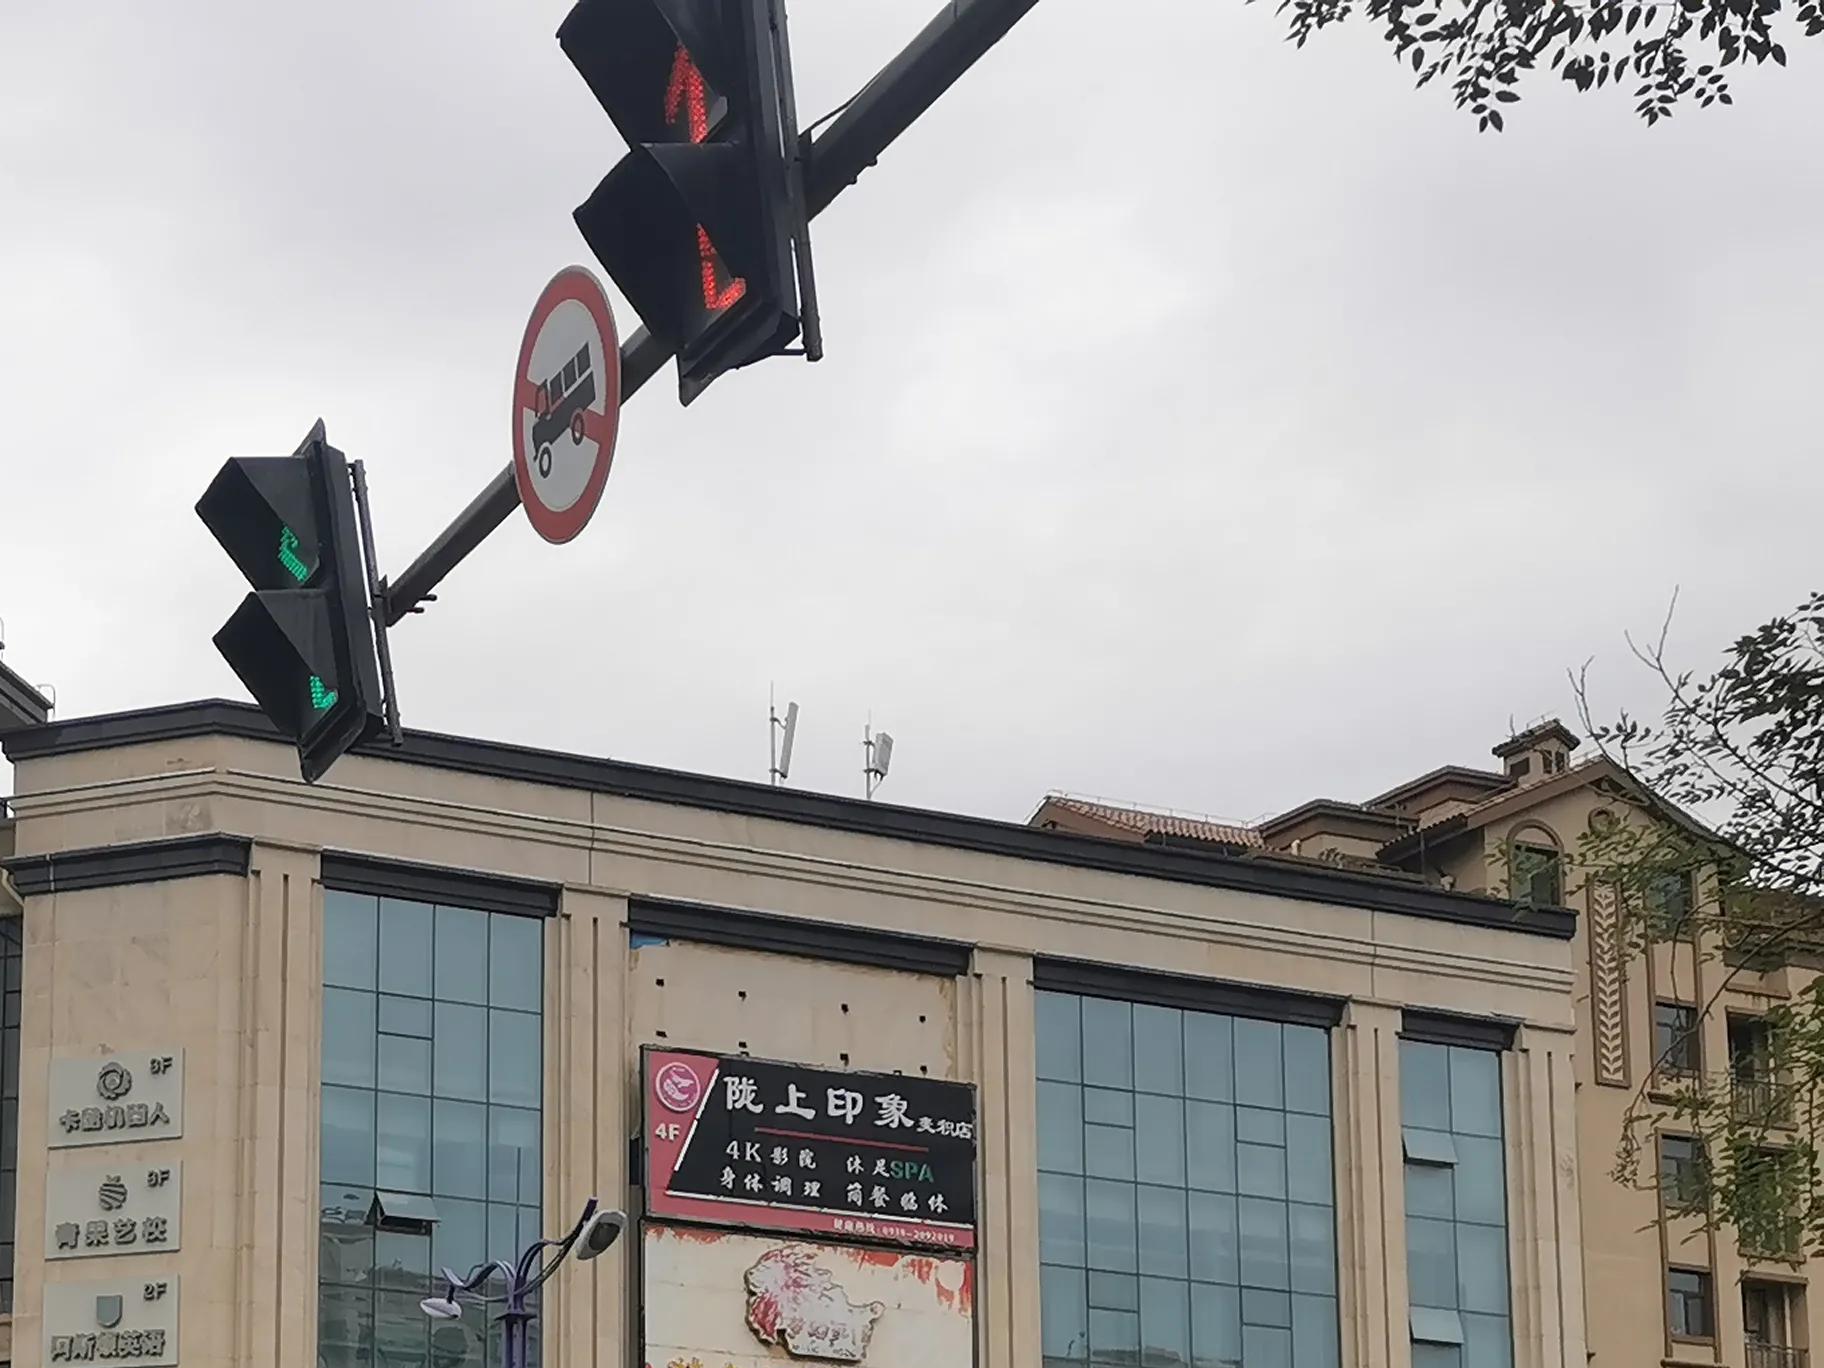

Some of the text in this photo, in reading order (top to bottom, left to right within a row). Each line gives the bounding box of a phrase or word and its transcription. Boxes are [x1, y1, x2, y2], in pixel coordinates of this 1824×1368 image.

[723, 1075, 914, 1129] 陇上印象
[655, 1123, 680, 1142] 4F
